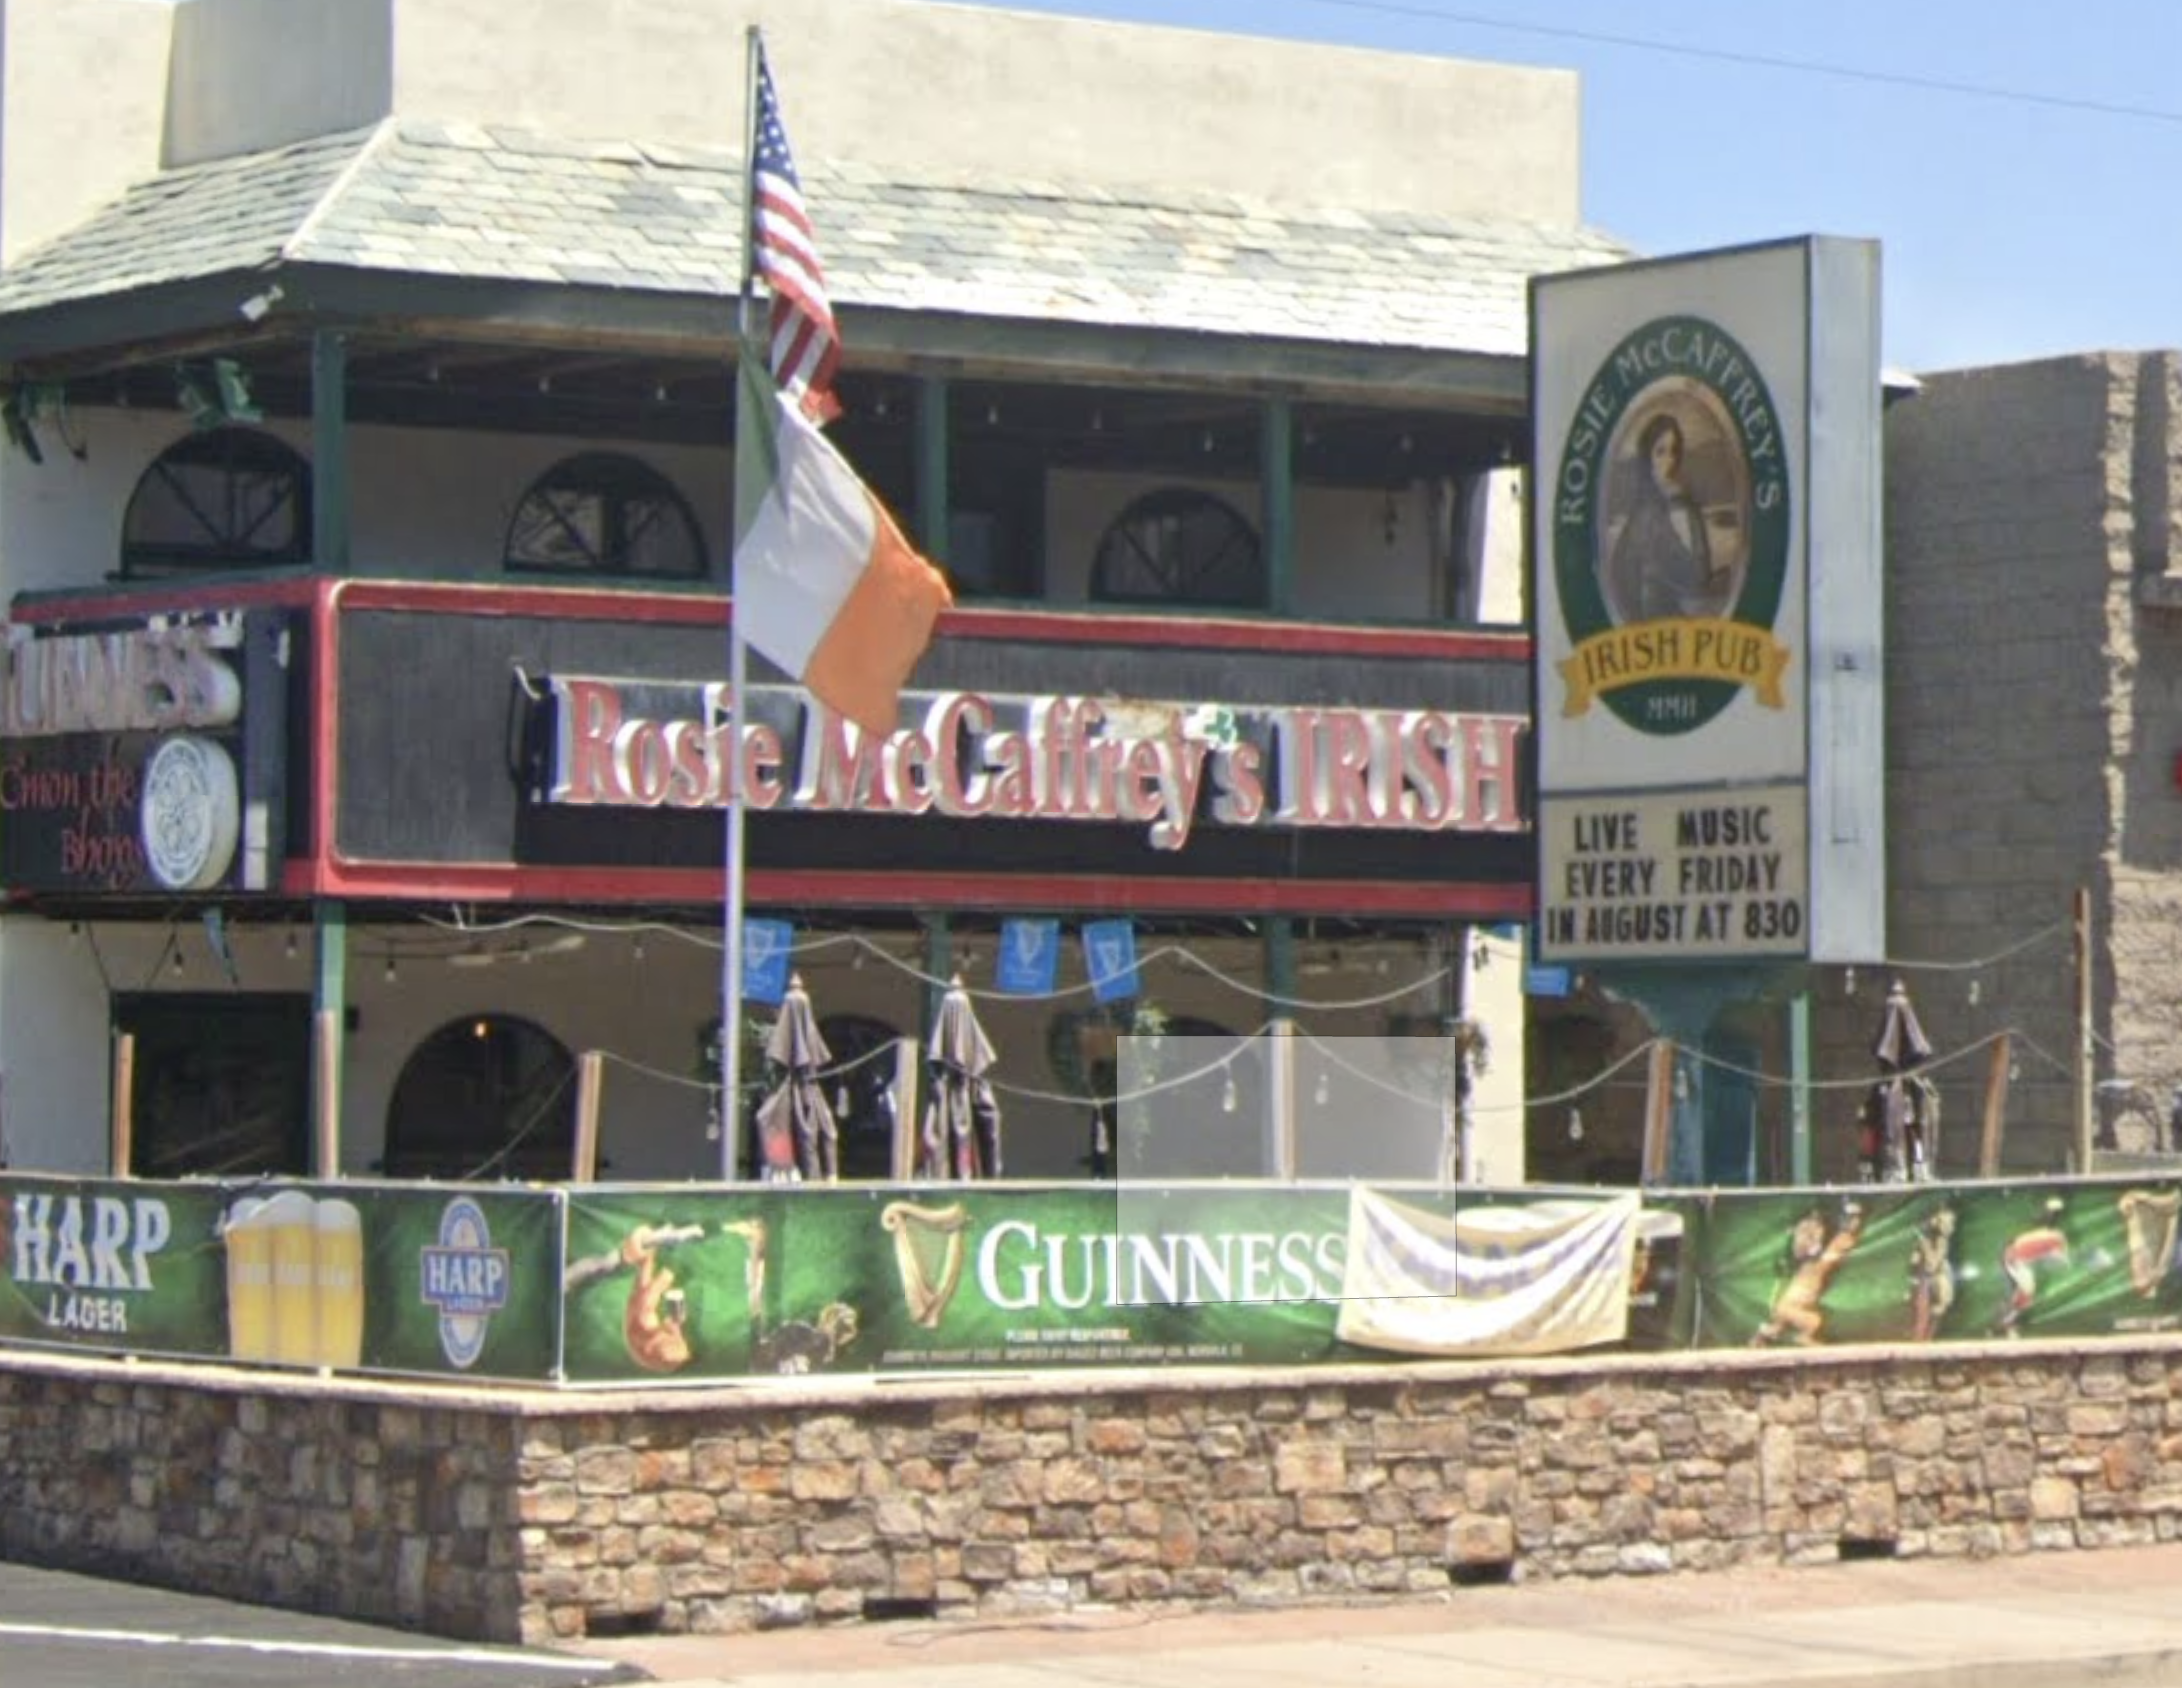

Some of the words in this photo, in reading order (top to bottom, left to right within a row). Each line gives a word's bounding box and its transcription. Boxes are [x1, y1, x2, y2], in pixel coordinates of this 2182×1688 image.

[1561, 384, 1615, 524] ROSIE
[1615, 327, 1781, 510] McCAFFREY'S
[1583, 627, 1680, 685] IRISH
[1692, 627, 1762, 677] PUB
[1648, 694, 1698, 721] MMII
[553, 680, 783, 808] Rosie
[793, 690, 1264, 851] McCaffrey's
[1268, 706, 1529, 832] IRISH
[1573, 812, 1638, 852] LIVE
[1676, 806, 1771, 848] MUSIC
[1565, 857, 1656, 899] EVERY
[1678, 852, 1781, 895] FRIDAY
[1546, 906, 1575, 944] IN
[1585, 903, 1687, 944] AUGUST
[1694, 901, 1732, 940] AT
[1744, 899, 1800, 940] 830
[12, 1193, 171, 1291] HARP
[977, 1220, 1346, 1311] GUINNESS
[428, 1254, 503, 1297] HARP
[47, 1294, 128, 1332] LAGER
